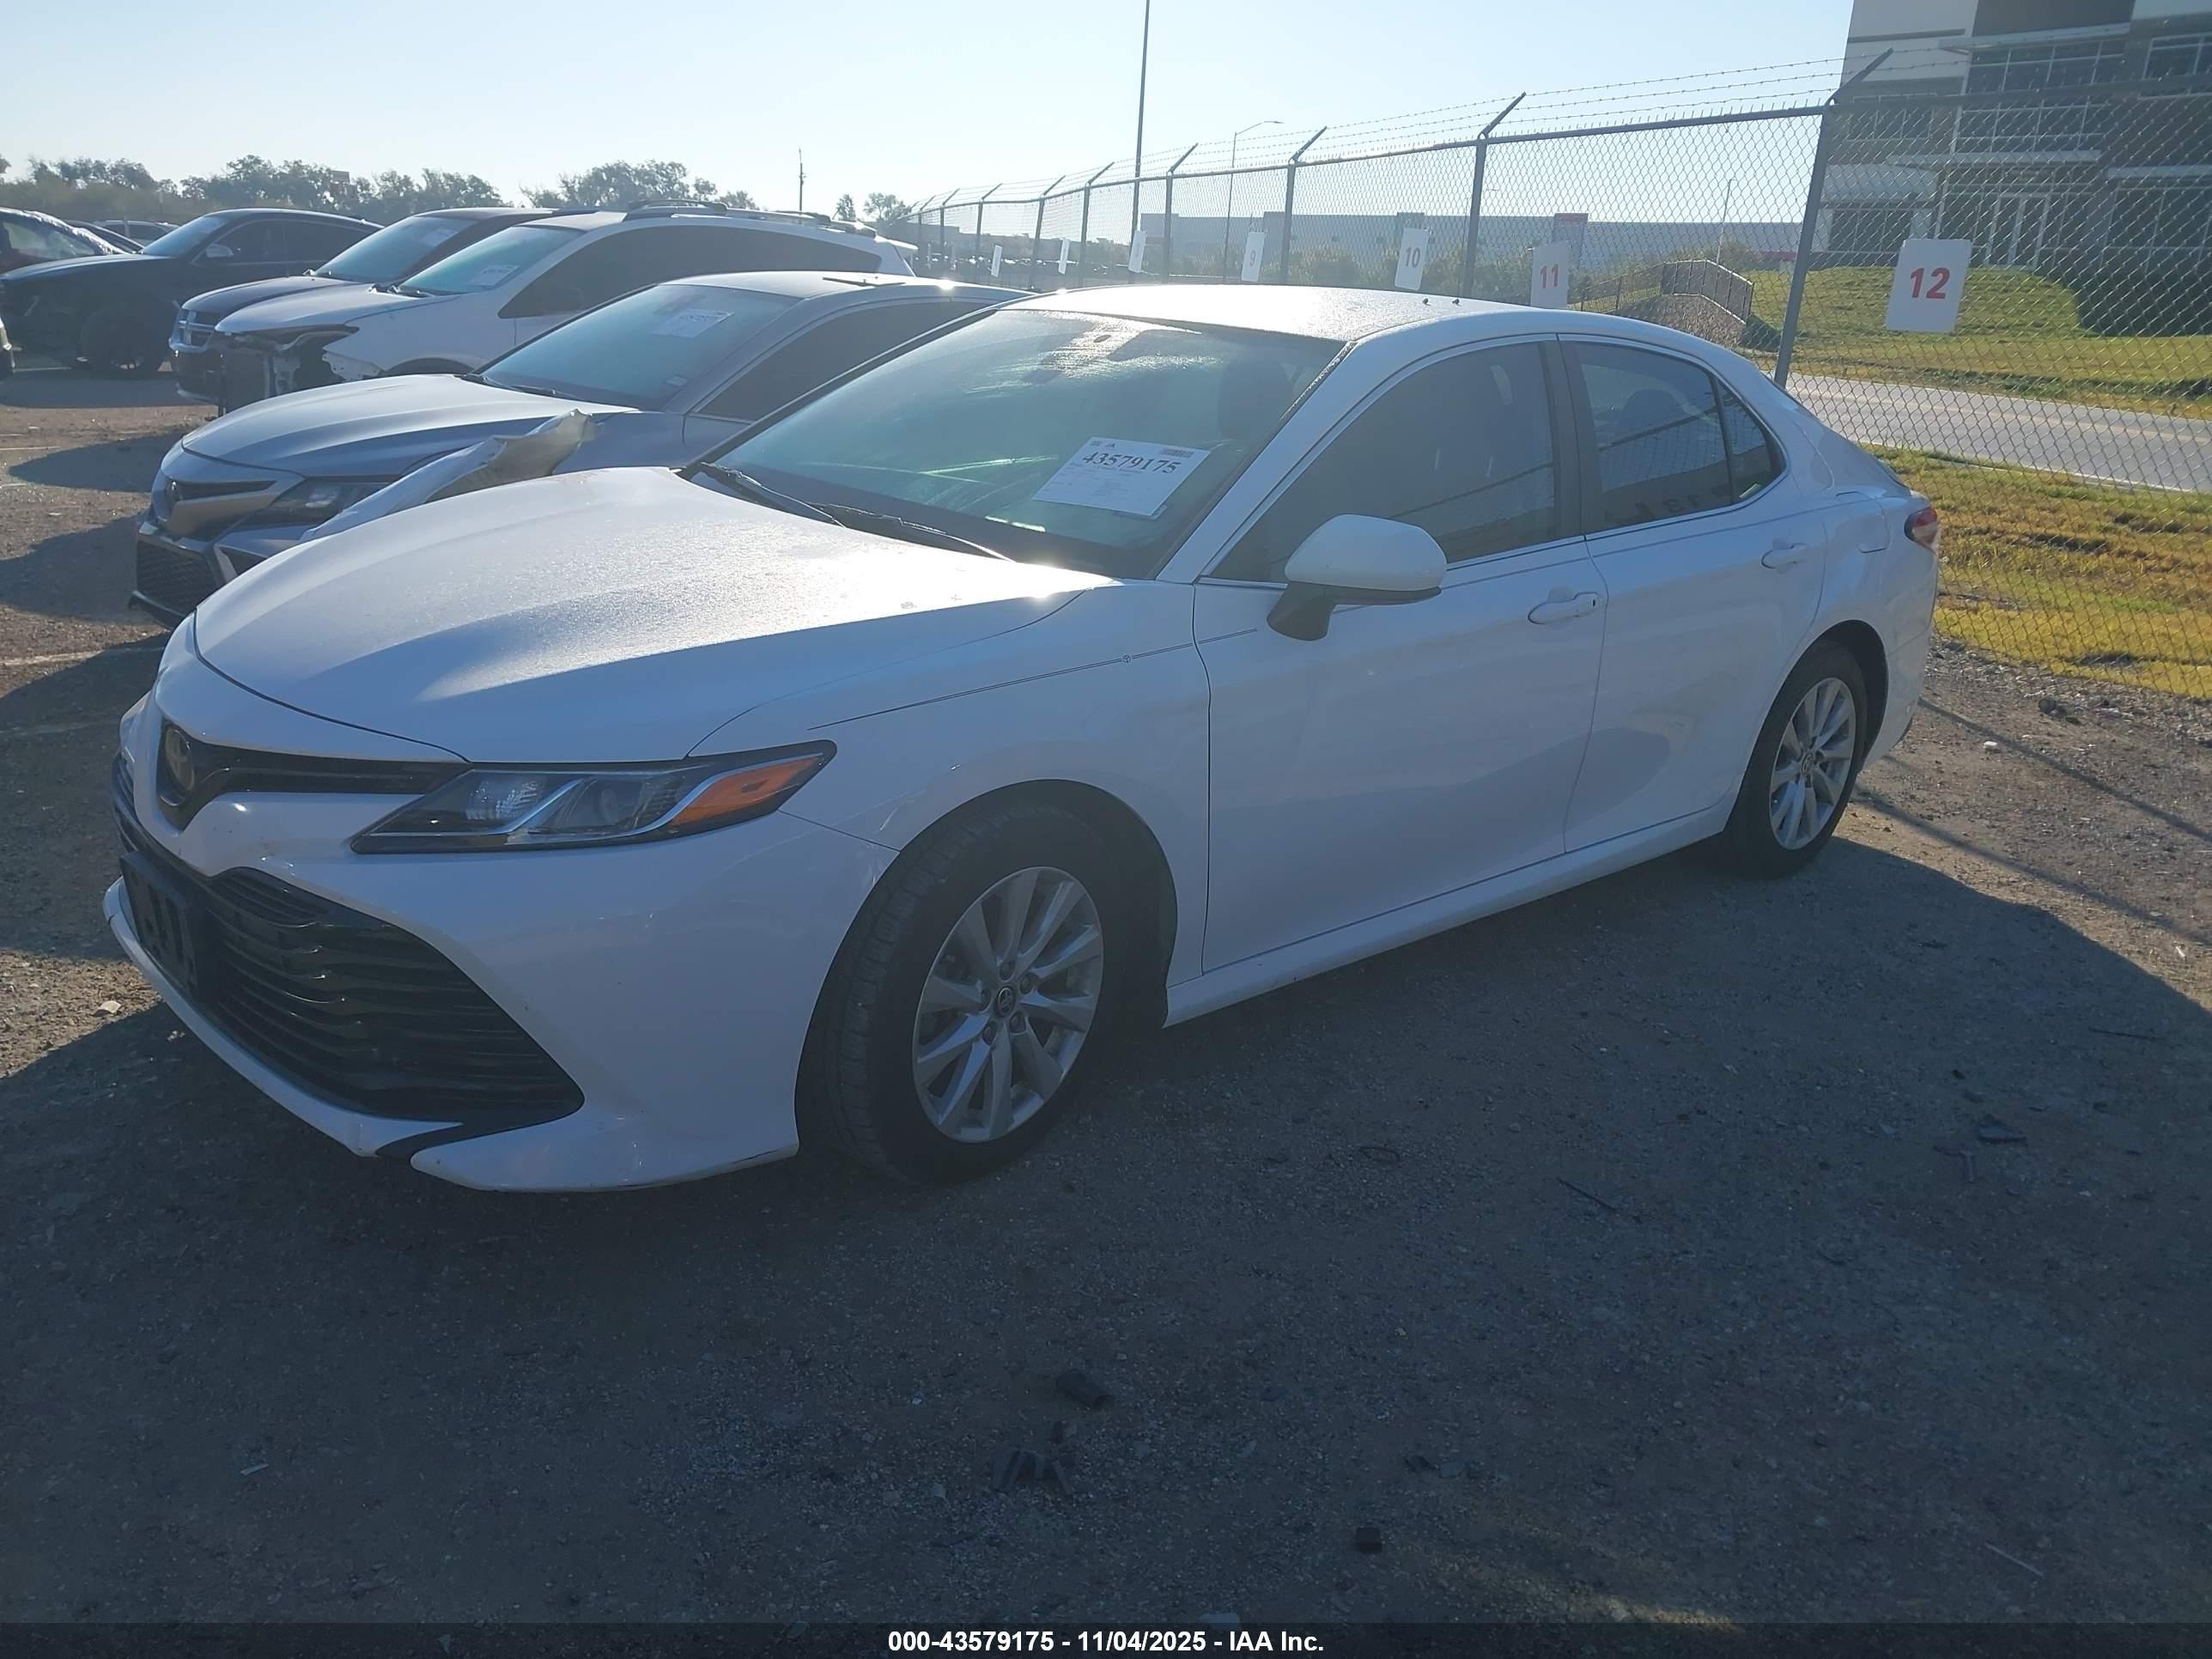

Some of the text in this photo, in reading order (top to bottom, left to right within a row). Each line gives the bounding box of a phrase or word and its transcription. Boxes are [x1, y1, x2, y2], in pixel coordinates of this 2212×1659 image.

[1249, 249, 1257, 267] 9
[1405, 246, 1421, 269] 10
[1539, 263, 1560, 289] 11
[1909, 266, 1951, 300] 12
[1082, 451, 1182, 474] 43579175
